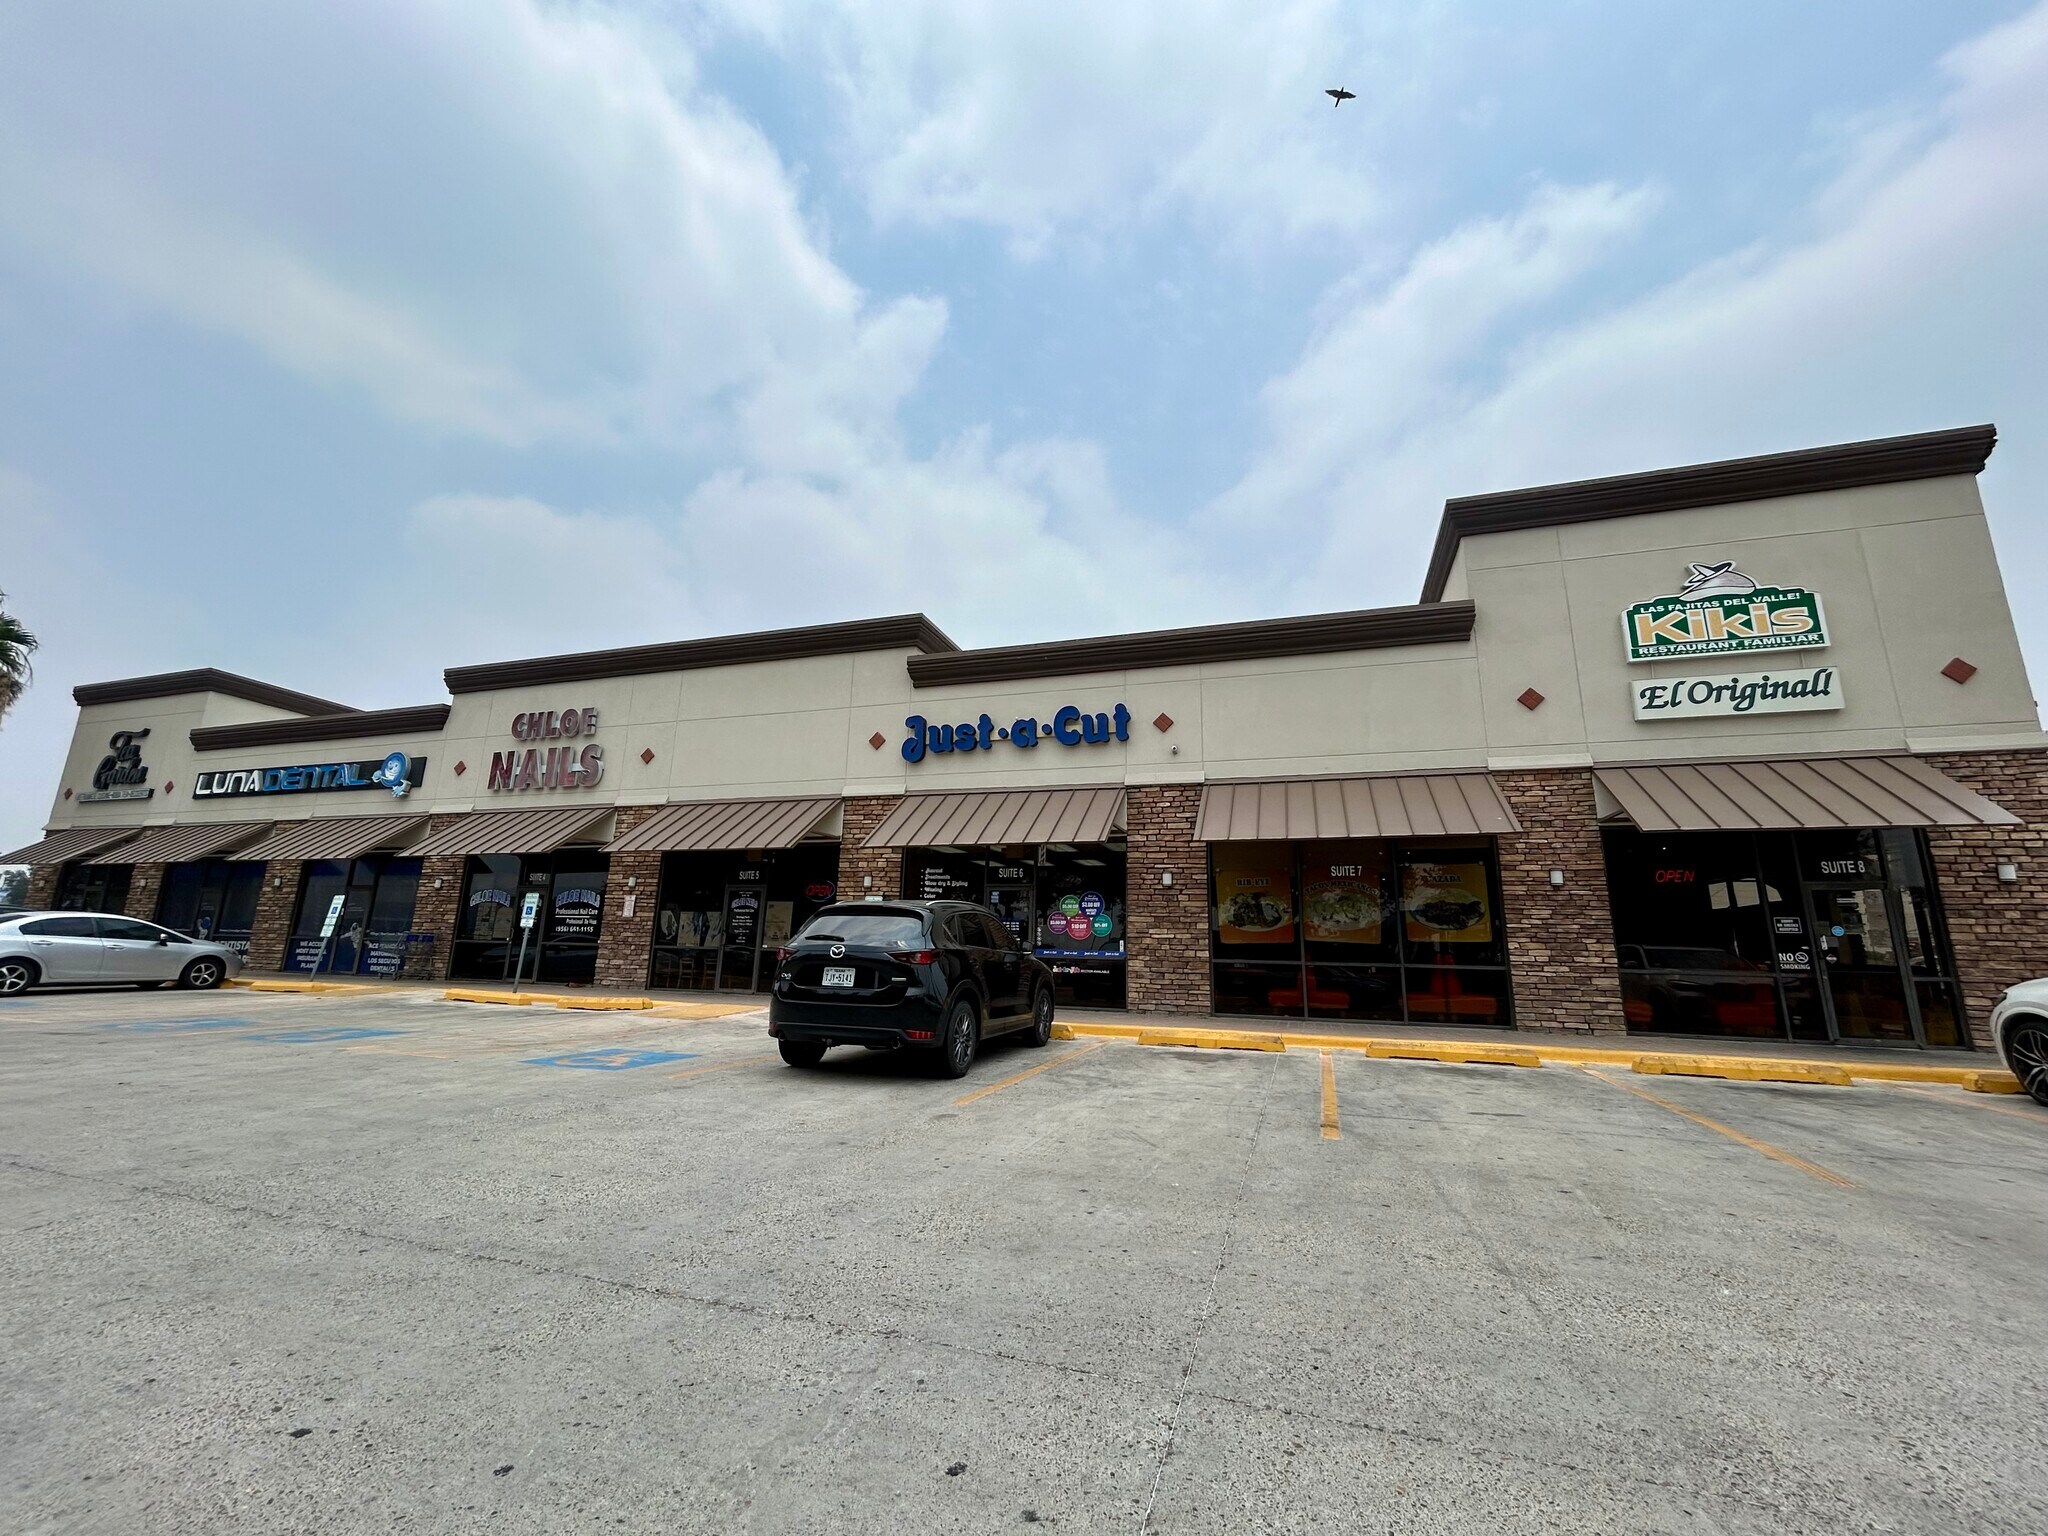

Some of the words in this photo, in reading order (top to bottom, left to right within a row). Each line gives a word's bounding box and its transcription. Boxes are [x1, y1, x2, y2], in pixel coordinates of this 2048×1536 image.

[1640, 604, 1665, 613] LAS
[1668, 600, 1720, 612] FAJITAS
[1723, 598, 1750, 607] DEL
[1752, 592, 1801, 604] VALLE!
[1638, 639, 1739, 655] RESTAURANT
[1744, 633, 1820, 647] FAMILIAR
[1640, 680, 1687, 710] El
[511, 707, 598, 741] CHLOE
[487, 744, 605, 791] NAILS
[998, 868, 1018, 878] SUITE
[1018, 868, 1024, 878] 6
[1330, 865, 1356, 877] SUITE
[1356, 865, 1363, 877] 7
[1820, 860, 1857, 874] SUITE
[1857, 860, 1866, 873] 8
[738, 870, 755, 880] SUITE
[755, 870, 760, 880] 5
[1655, 870, 1695, 883] OPEN
[806, 884, 833, 897] OPEN
[1777, 952, 1794, 962] NO
